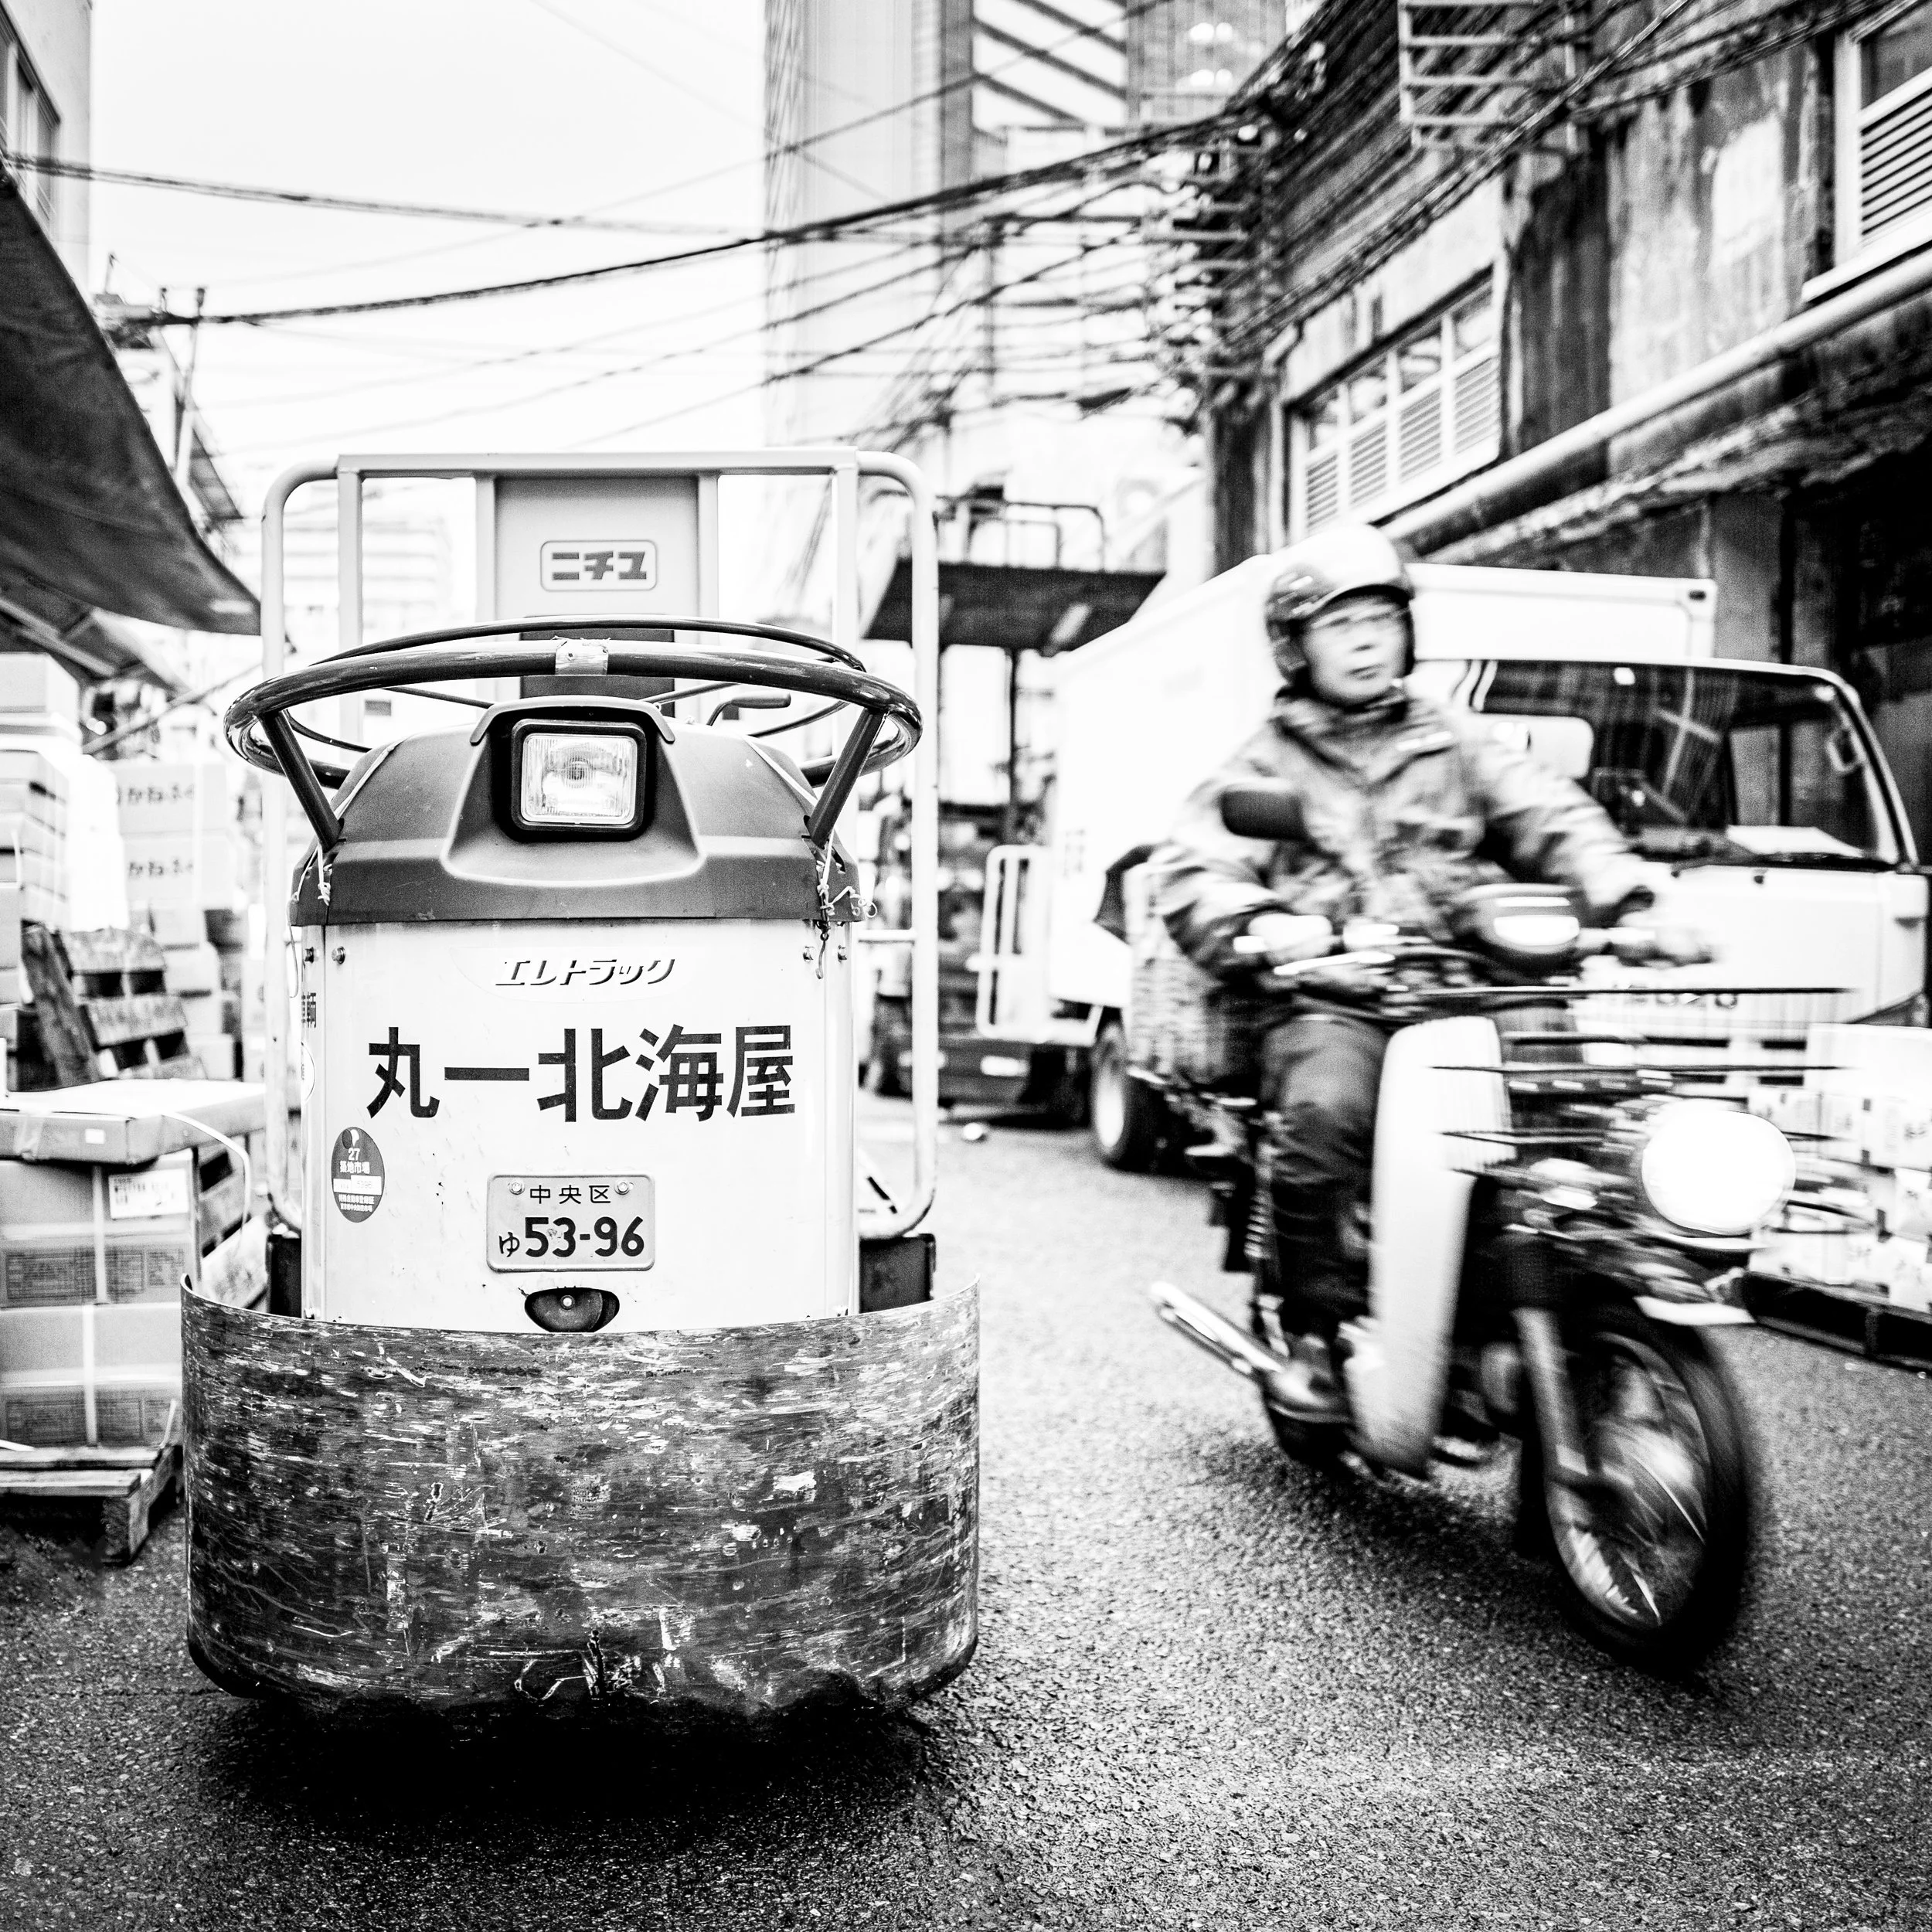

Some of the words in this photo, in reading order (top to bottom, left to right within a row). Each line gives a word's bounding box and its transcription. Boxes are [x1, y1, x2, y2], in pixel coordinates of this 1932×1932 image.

[552, 550, 647, 580] ニチユ
[493, 958, 676, 986] エレトラック
[367, 1024, 796, 1123] 丸一北海屋
[348, 1147, 361, 1161] 27
[529, 1185, 611, 1204] 中央区
